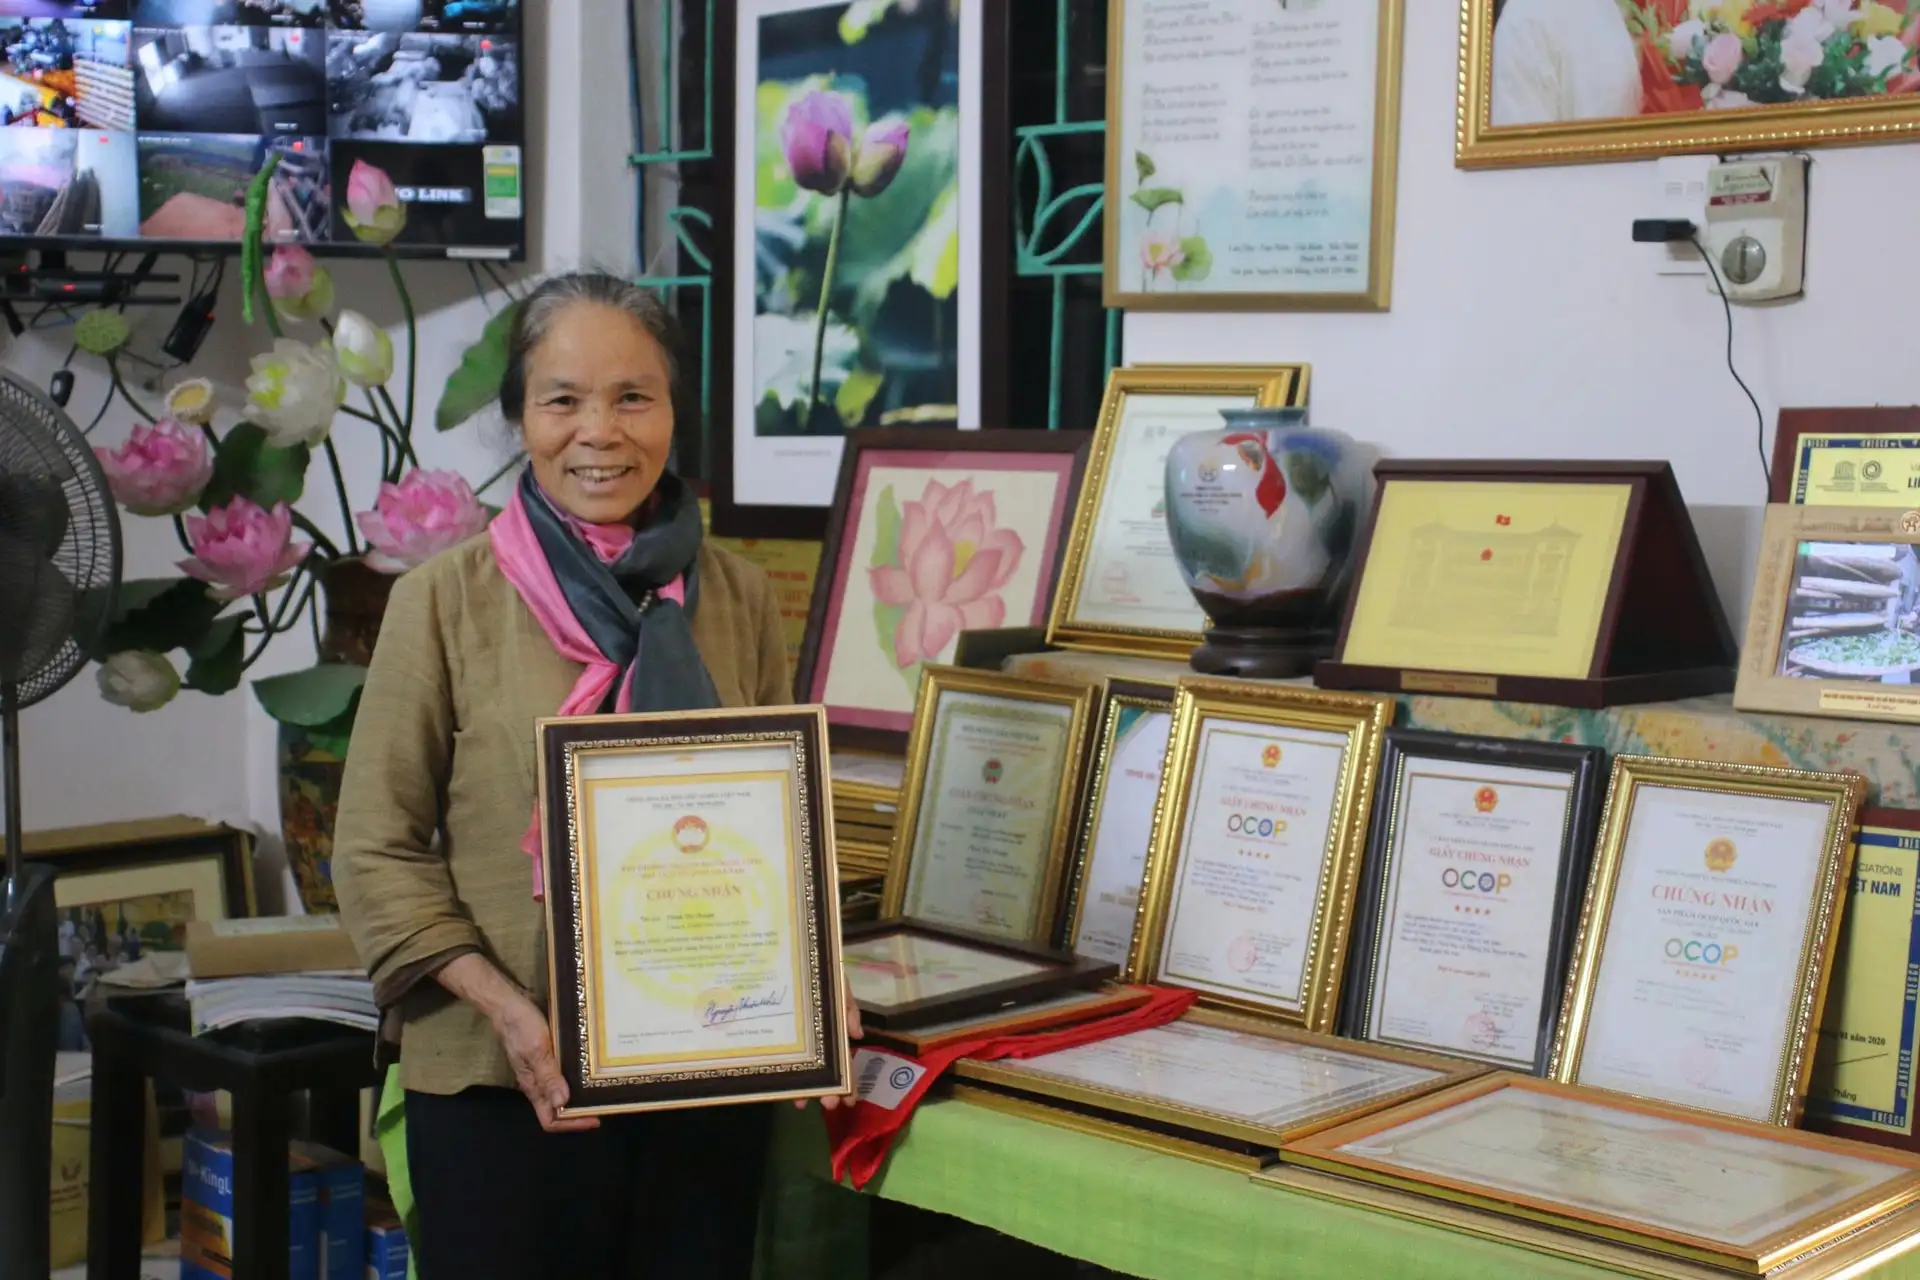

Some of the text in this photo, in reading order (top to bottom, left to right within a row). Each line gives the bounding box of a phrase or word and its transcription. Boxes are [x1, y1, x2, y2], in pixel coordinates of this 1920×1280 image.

[394, 187, 464, 203] O LINK
[1227, 813, 1289, 839] OCOP
[1441, 868, 1512, 895] OCOP
[1870, 879, 1902, 897] NAM
[1651, 883, 1775, 916] CHỨNG NHẬN
[1664, 937, 1740, 966] OCOP
[1868, 1035, 1886, 1046] 2020
[1871, 1111, 1905, 1127] UNESCO
